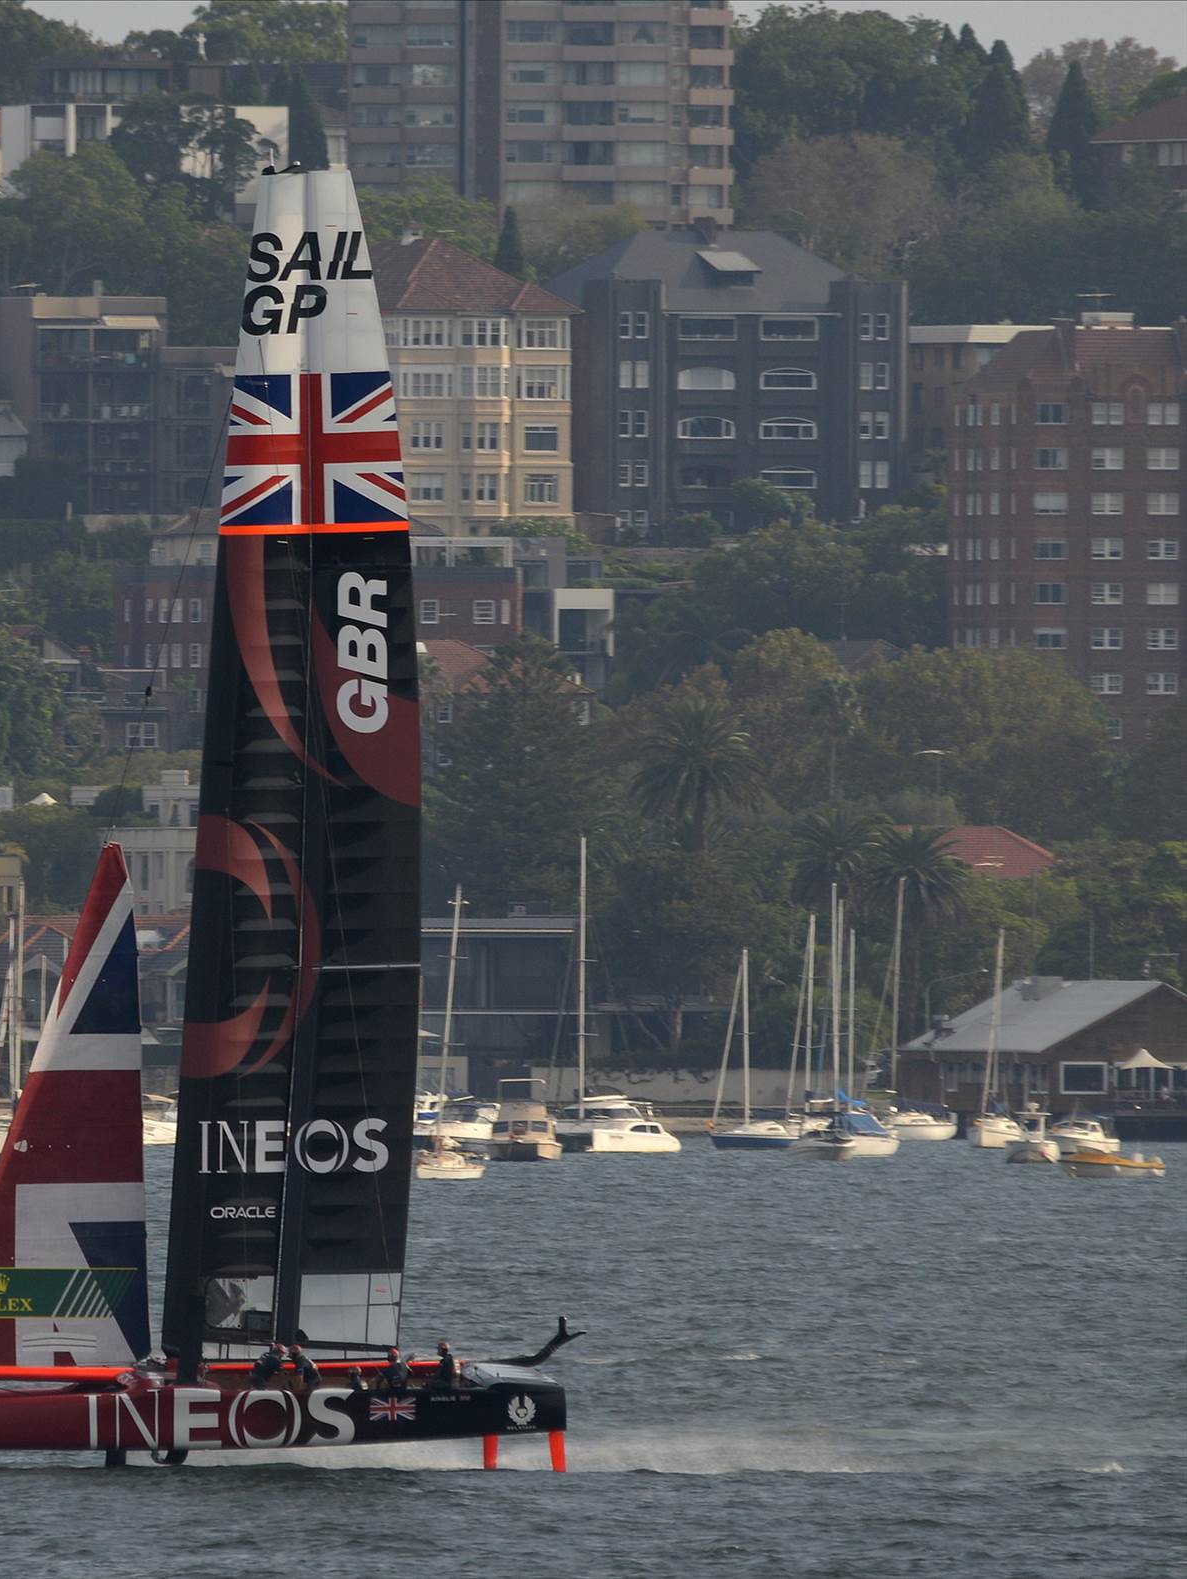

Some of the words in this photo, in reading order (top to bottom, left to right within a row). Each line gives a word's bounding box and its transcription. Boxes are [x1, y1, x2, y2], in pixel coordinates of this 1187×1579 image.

[247, 231, 372, 282] SAIL
[241, 284, 327, 335] GP
[336, 571, 389, 735] GBR
[198, 1118, 390, 1174] INEOS
[210, 1206, 277, 1219] ORACLE
[87, 1387, 355, 1449] INEOS
